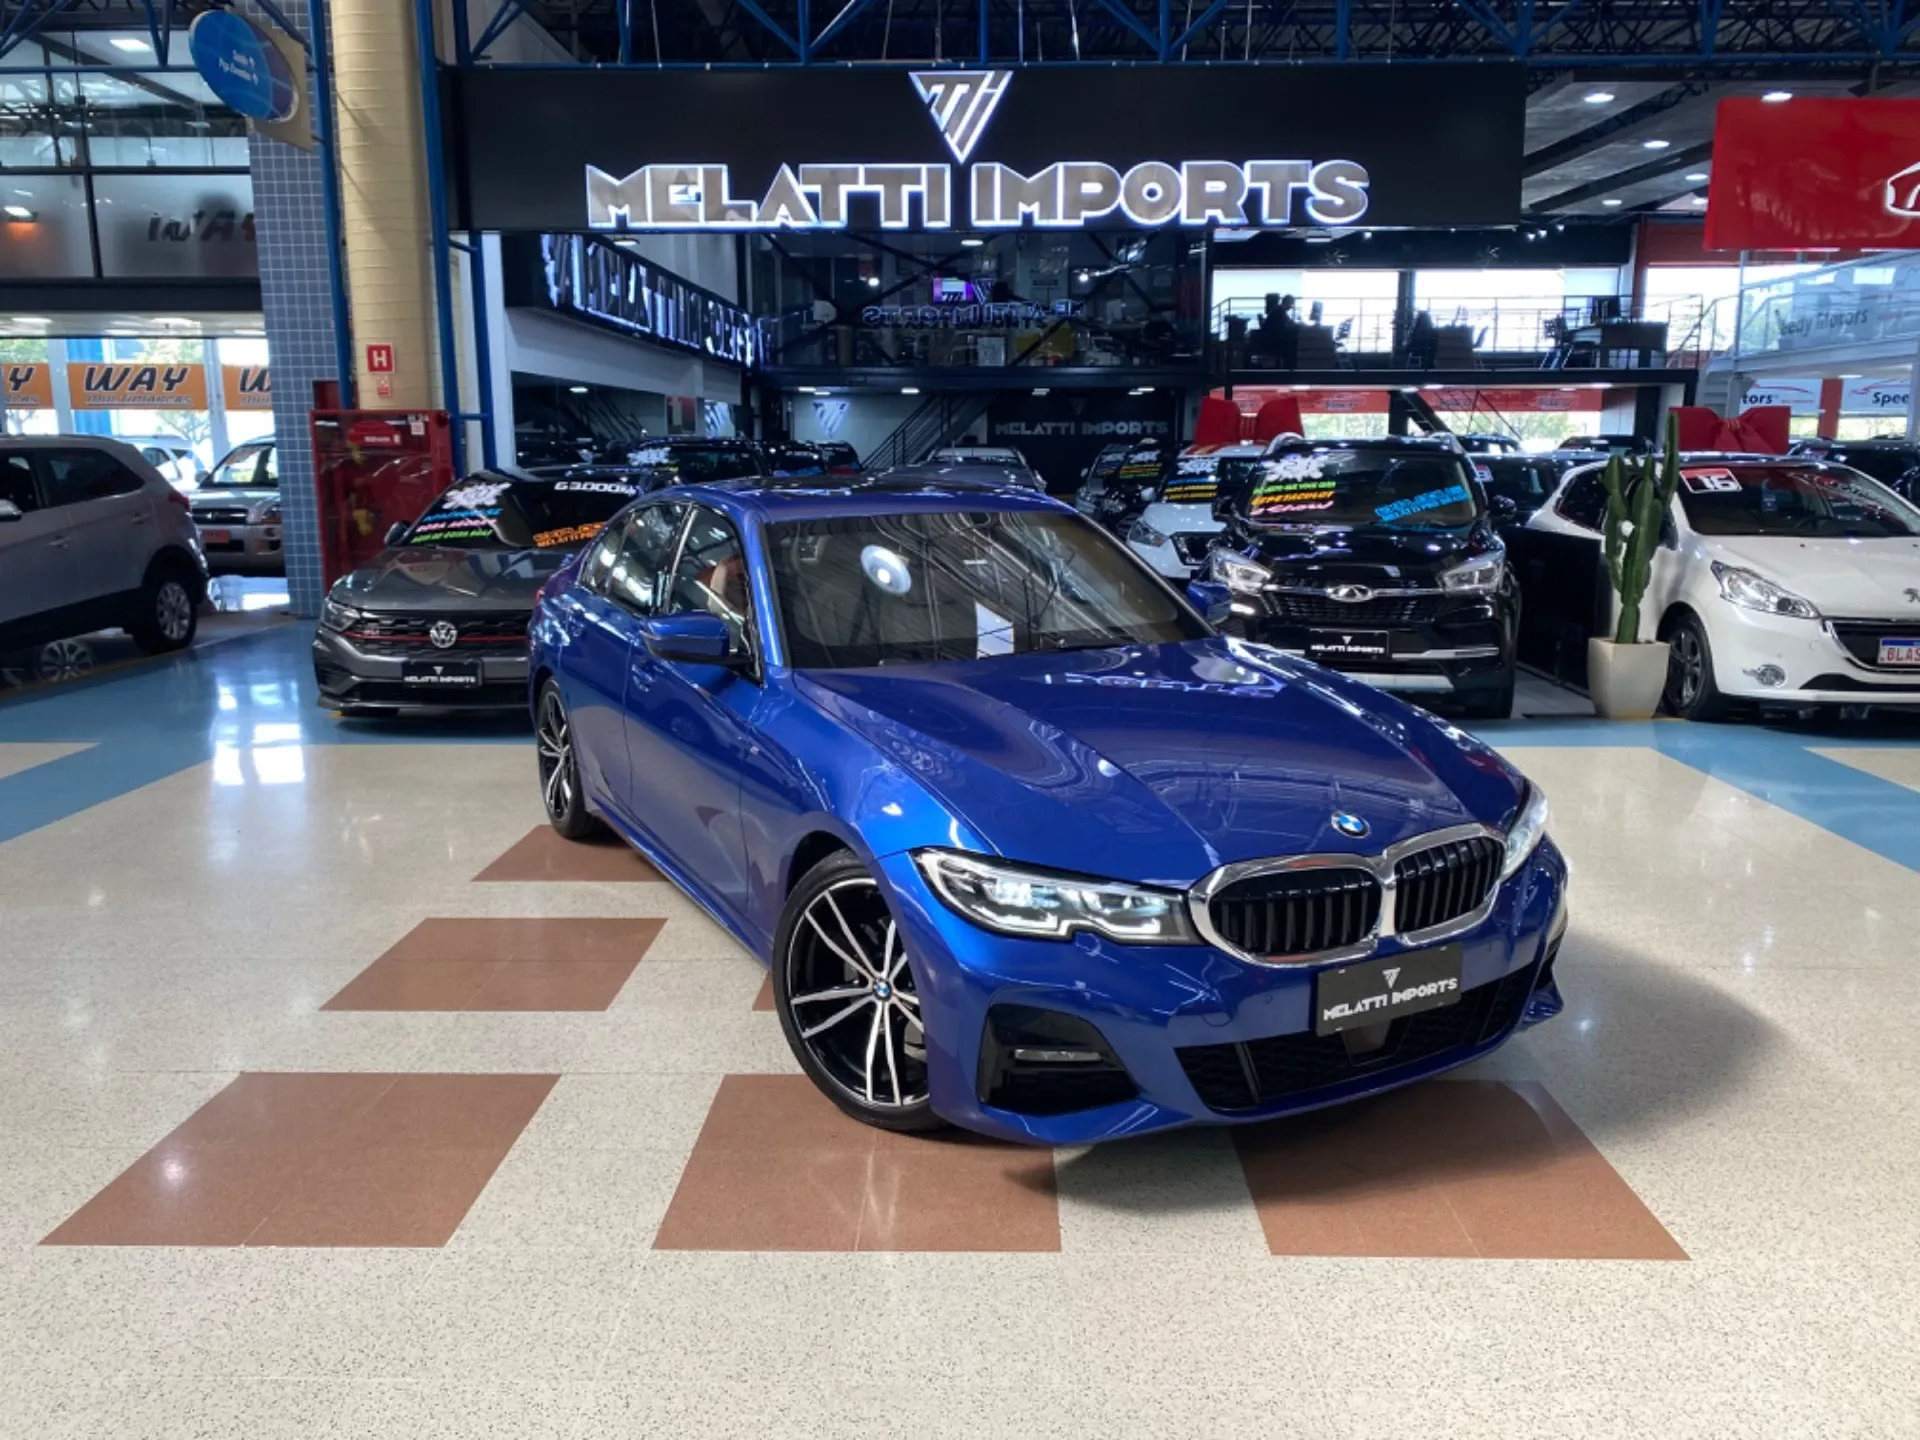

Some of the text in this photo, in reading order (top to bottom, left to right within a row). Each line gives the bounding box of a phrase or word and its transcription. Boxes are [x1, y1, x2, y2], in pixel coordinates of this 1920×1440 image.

[585, 159, 1370, 229] MELATTI IMPORTS
[371, 350, 388, 368] H
[84, 366, 189, 393] WAY
[994, 420, 1168, 436] MELATTI IMPORTS
[1323, 977, 1458, 1021] MELATTI IMPORTS
